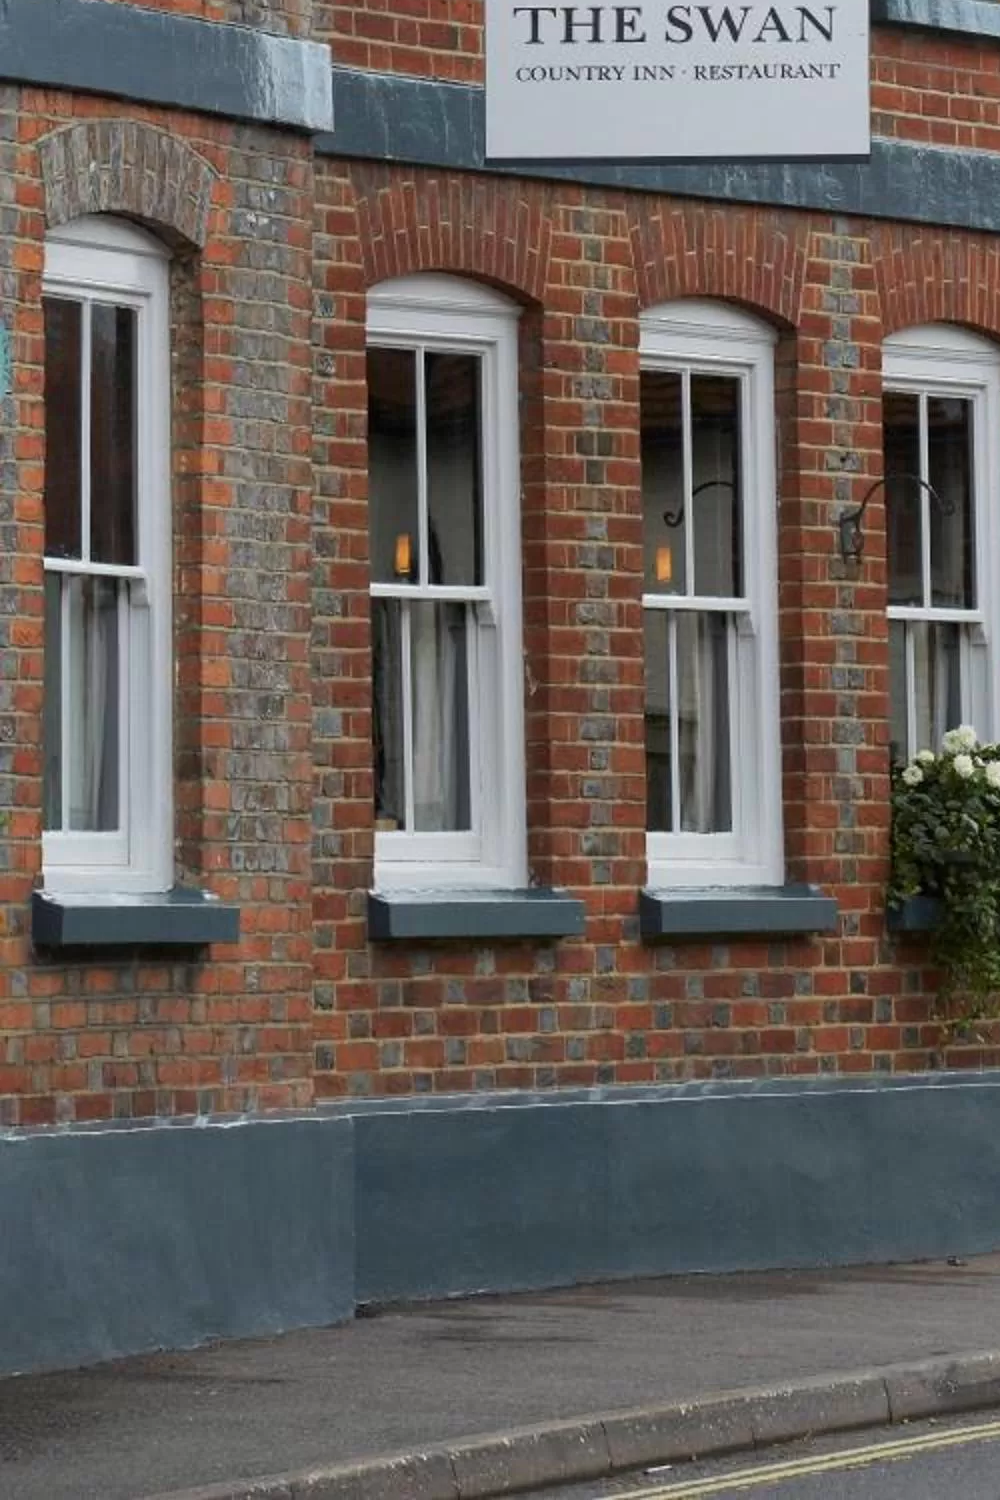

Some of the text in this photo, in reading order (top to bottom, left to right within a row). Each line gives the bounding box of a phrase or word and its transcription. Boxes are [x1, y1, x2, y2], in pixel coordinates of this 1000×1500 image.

[513, 5, 837, 45] THE SWAN
[516, 63, 841, 81] COUNTRY INN RESTAURANT
